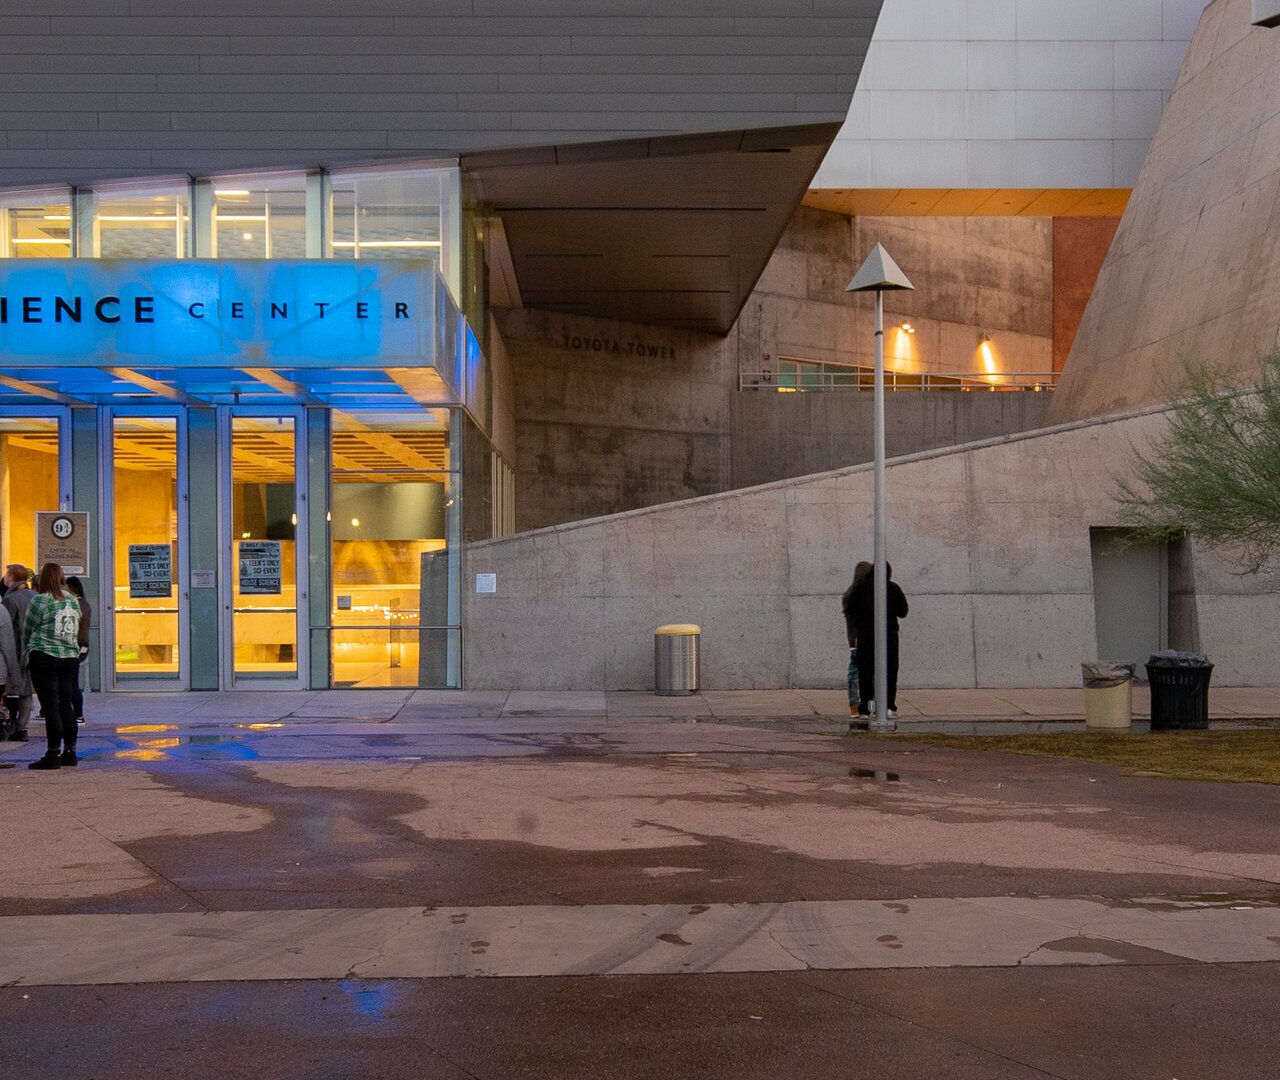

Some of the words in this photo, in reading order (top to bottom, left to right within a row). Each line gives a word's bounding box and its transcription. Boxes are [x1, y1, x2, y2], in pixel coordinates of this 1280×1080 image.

[188, 302, 410, 319] CENTER
[563, 335, 620, 354] TOYOTA
[626, 342, 676, 360] TOWER
[139, 562, 156, 570] TEEN'S
[157, 562, 169, 570] ONLY
[249, 559, 266, 567] TEEN'S
[267, 559, 279, 567] ONLY
